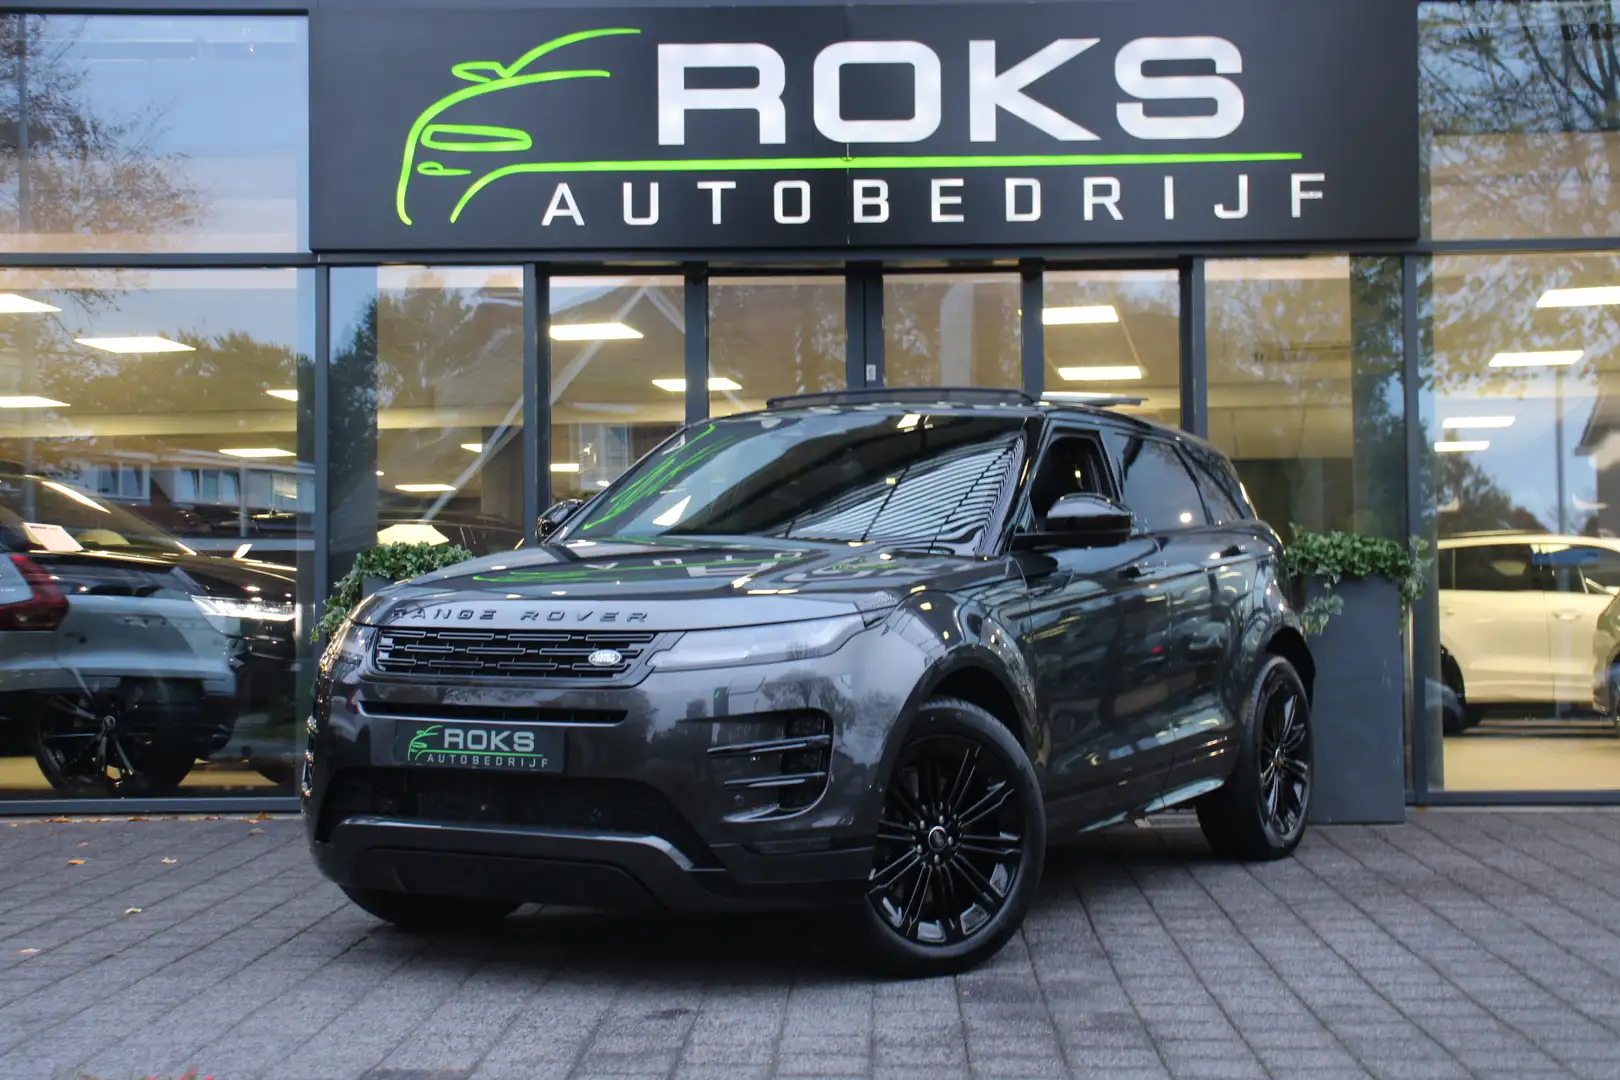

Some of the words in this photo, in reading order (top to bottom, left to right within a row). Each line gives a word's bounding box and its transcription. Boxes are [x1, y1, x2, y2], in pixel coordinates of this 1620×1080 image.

[657, 36, 1245, 147] ROKS
[541, 173, 1326, 226] AUTOBEDRIJF
[391, 608, 497, 621] RANGE
[520, 610, 648, 623] ROVER
[443, 728, 535, 752] ROKS
[426, 753, 549, 769] AUTOBEDRIJF
